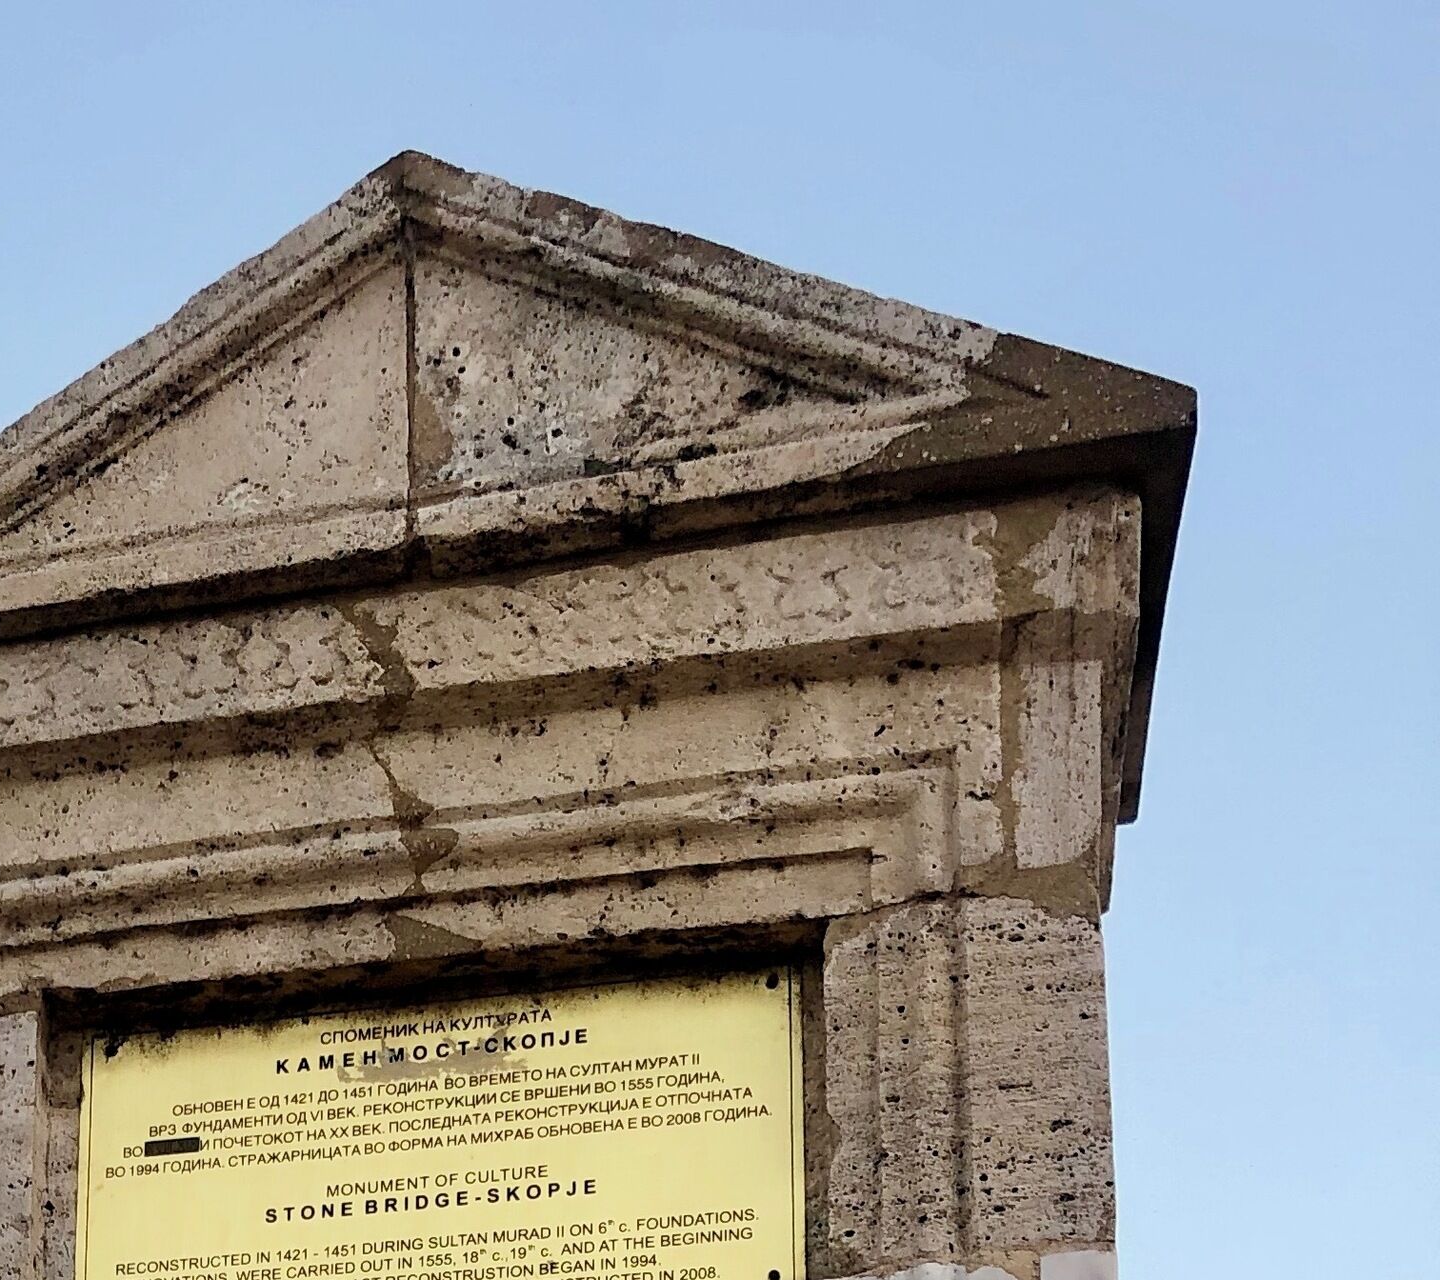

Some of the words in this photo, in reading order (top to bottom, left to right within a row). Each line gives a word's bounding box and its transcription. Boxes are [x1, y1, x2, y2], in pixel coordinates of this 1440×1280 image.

[320, 1023, 420, 1046] СПОМЕНИК
[423, 1020, 446, 1035] НА
[276, 1050, 378, 1075] КАМЕН
[149, 1123, 176, 1137] ВРЗ
[181, 1114, 283, 1133] ФУНДАМЕНТИ
[286, 1111, 307, 1125] ОД
[327, 1106, 359, 1120] ВЕК.
[363, 1093, 496, 1115] РЕКОНСТРУКЦИИ
[499, 1089, 520, 1103] СЕ
[524, 1083, 590, 1100] ВРШЕНИ
[594, 1080, 616, 1093] ВО
[620, 1077, 653, 1090] 1555
[656, 1071, 724, 1087] ГОДИНА,
[172, 1099, 243, 1116] ОБНОВЕН
[246, 1097, 255, 1109] Е
[258, 1095, 280, 1109] ОД
[283, 1092, 312, 1105] 1421
[317, 1089, 339, 1104] ДО
[342, 1086, 372, 1099] 1451
[377, 1077, 438, 1096] ГОДИНА
[444, 1075, 466, 1089] ВО
[469, 1069, 542, 1087] ВРЕМЕТО
[545, 1066, 567, 1079] НА
[569, 1060, 631, 1076] СУЛТАН
[635, 1054, 688, 1070] МУРАТ
[692, 1053, 699, 1064] II
[105, 1166, 125, 1178] ВО
[129, 1163, 159, 1175] 1994
[162, 1157, 224, 1173] ГОДИНА.
[228, 1144, 361, 1166] СТРАЖАРНИЦАТА
[364, 1141, 385, 1154] ВО
[388, 1136, 443, 1151] ФОРМА
[446, 1133, 467, 1146] НА
[470, 1127, 534, 1143] МИХРАБ
[537, 1119, 624, 1137] ОБНОВЕНА
[627, 1117, 637, 1129] Е
[641, 1115, 663, 1128] ВО
[666, 1111, 701, 1125] 2008
[704, 1104, 772, 1122] ГОДИНА.
[123, 1146, 144, 1159] ВО
[200, 1139, 210, 1151] И
[212, 1130, 303, 1148] ПОЧЕТОКОТ
[306, 1128, 326, 1140] НА
[352, 1123, 386, 1137] ВЕК.
[388, 1112, 491, 1132] ПОСЛЕДНАТА
[494, 1098, 639, 1121] РЕКОНСТРУКЦИЈА
[642, 1096, 651, 1108] Е
[655, 1087, 752, 1106] ОТПОЧНАТА
[326, 1175, 429, 1196] MONUMENT
[434, 1172, 458, 1187] OF
[464, 1164, 548, 1184] CULTURE
[265, 1201, 352, 1223] STONE
[115, 1253, 251, 1274] RECONSTRUCTED
[256, 1251, 270, 1263] IN
[276, 1248, 307, 1261] 1421
[324, 1244, 355, 1257] 1451
[362, 1237, 423, 1254] DURING
[428, 1232, 487, 1248] SULTAN
[493, 1227, 551, 1242] MURAD
[556, 1225, 564, 1237] II
[569, 1223, 593, 1236] ON
[636, 1208, 758, 1229] FOUNDATIONS.
[286, 1261, 355, 1278] CARRIED
[359, 1258, 392, 1272] OUT
[397, 1256, 412, 1269] IN
[418, 1253, 455, 1266] 1555,
[560, 1241, 594, 1255] AND
[598, 1238, 618, 1252] AT
[622, 1235, 654, 1249] THE
[660, 1227, 752, 1246] BEGINNING
[539, 1259, 594, 1275] BEGAN
[600, 1257, 615, 1270] IN
[622, 1254, 661, 1267] 1994.
[679, 1266, 720, 1280] 2008.
